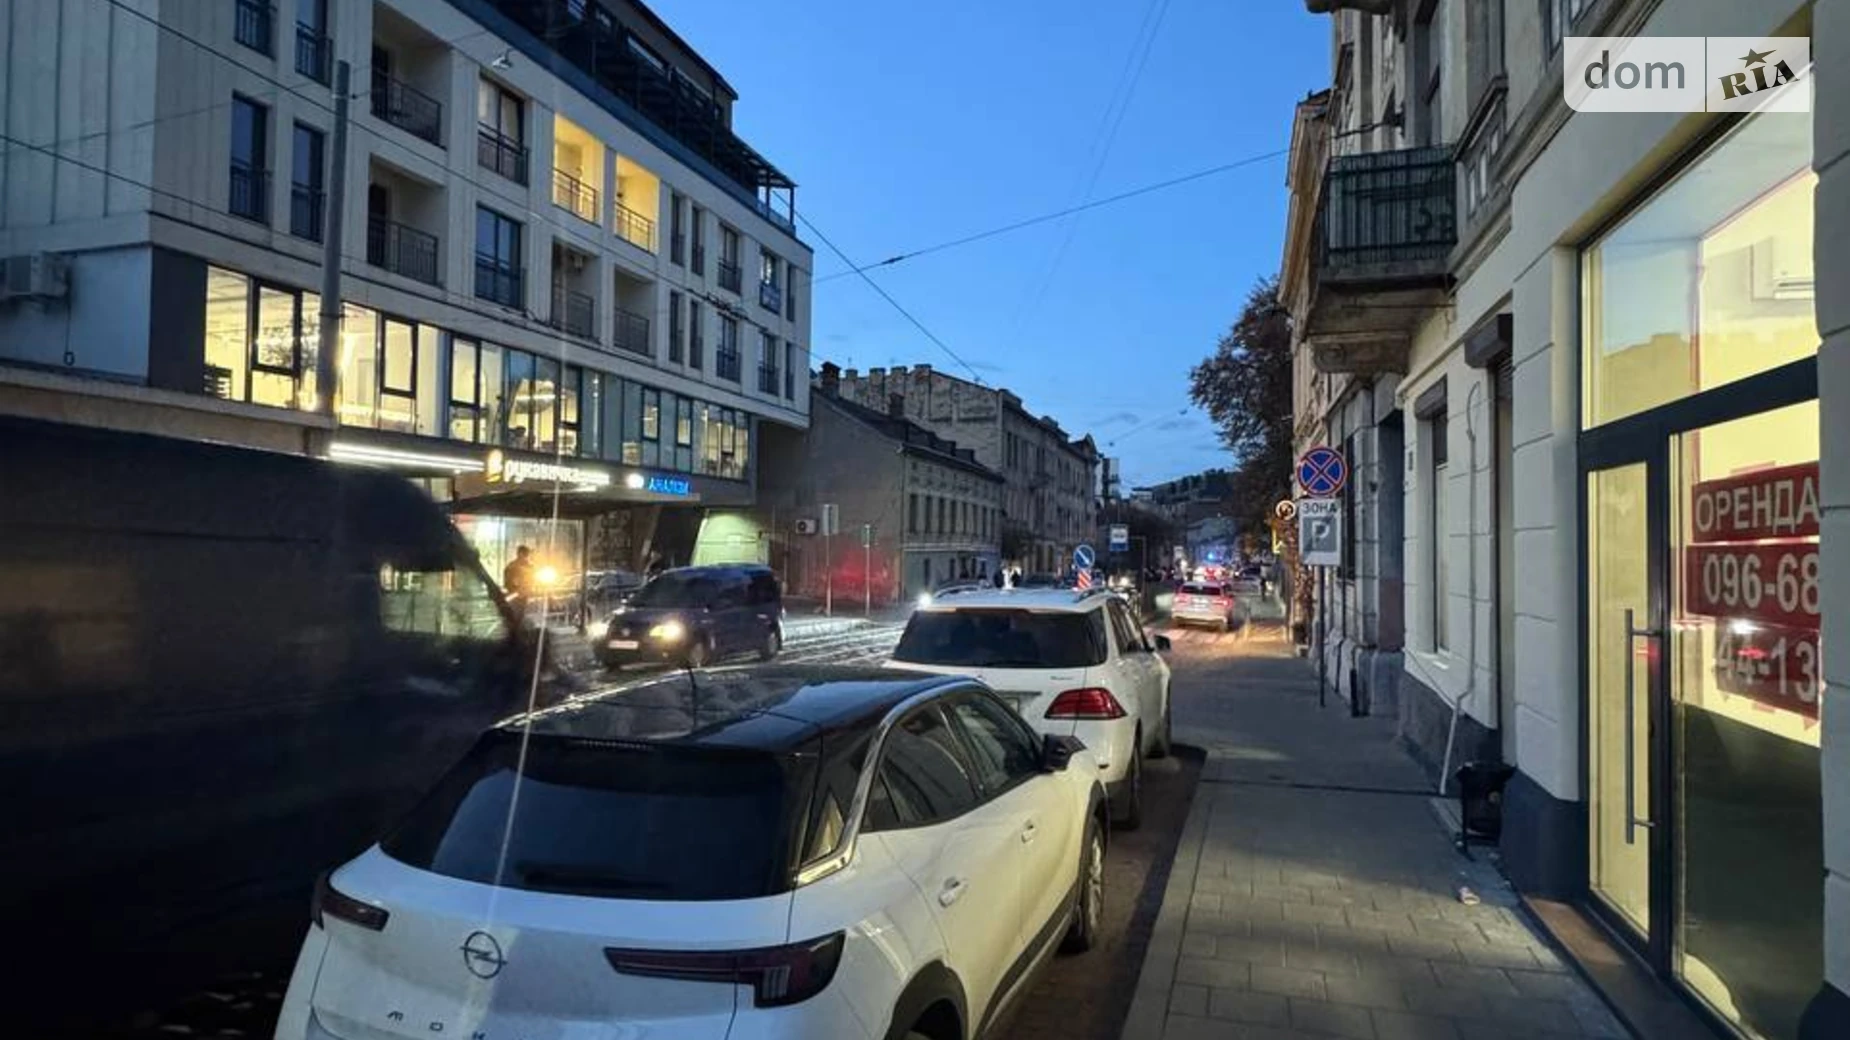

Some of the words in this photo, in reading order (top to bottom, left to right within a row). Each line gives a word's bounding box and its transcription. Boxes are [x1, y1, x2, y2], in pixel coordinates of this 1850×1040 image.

[1303, 502, 1338, 514] ЗОНА
[1695, 476, 1820, 535] ОРЕНДА
[1703, 553, 1820, 616] 096-68
